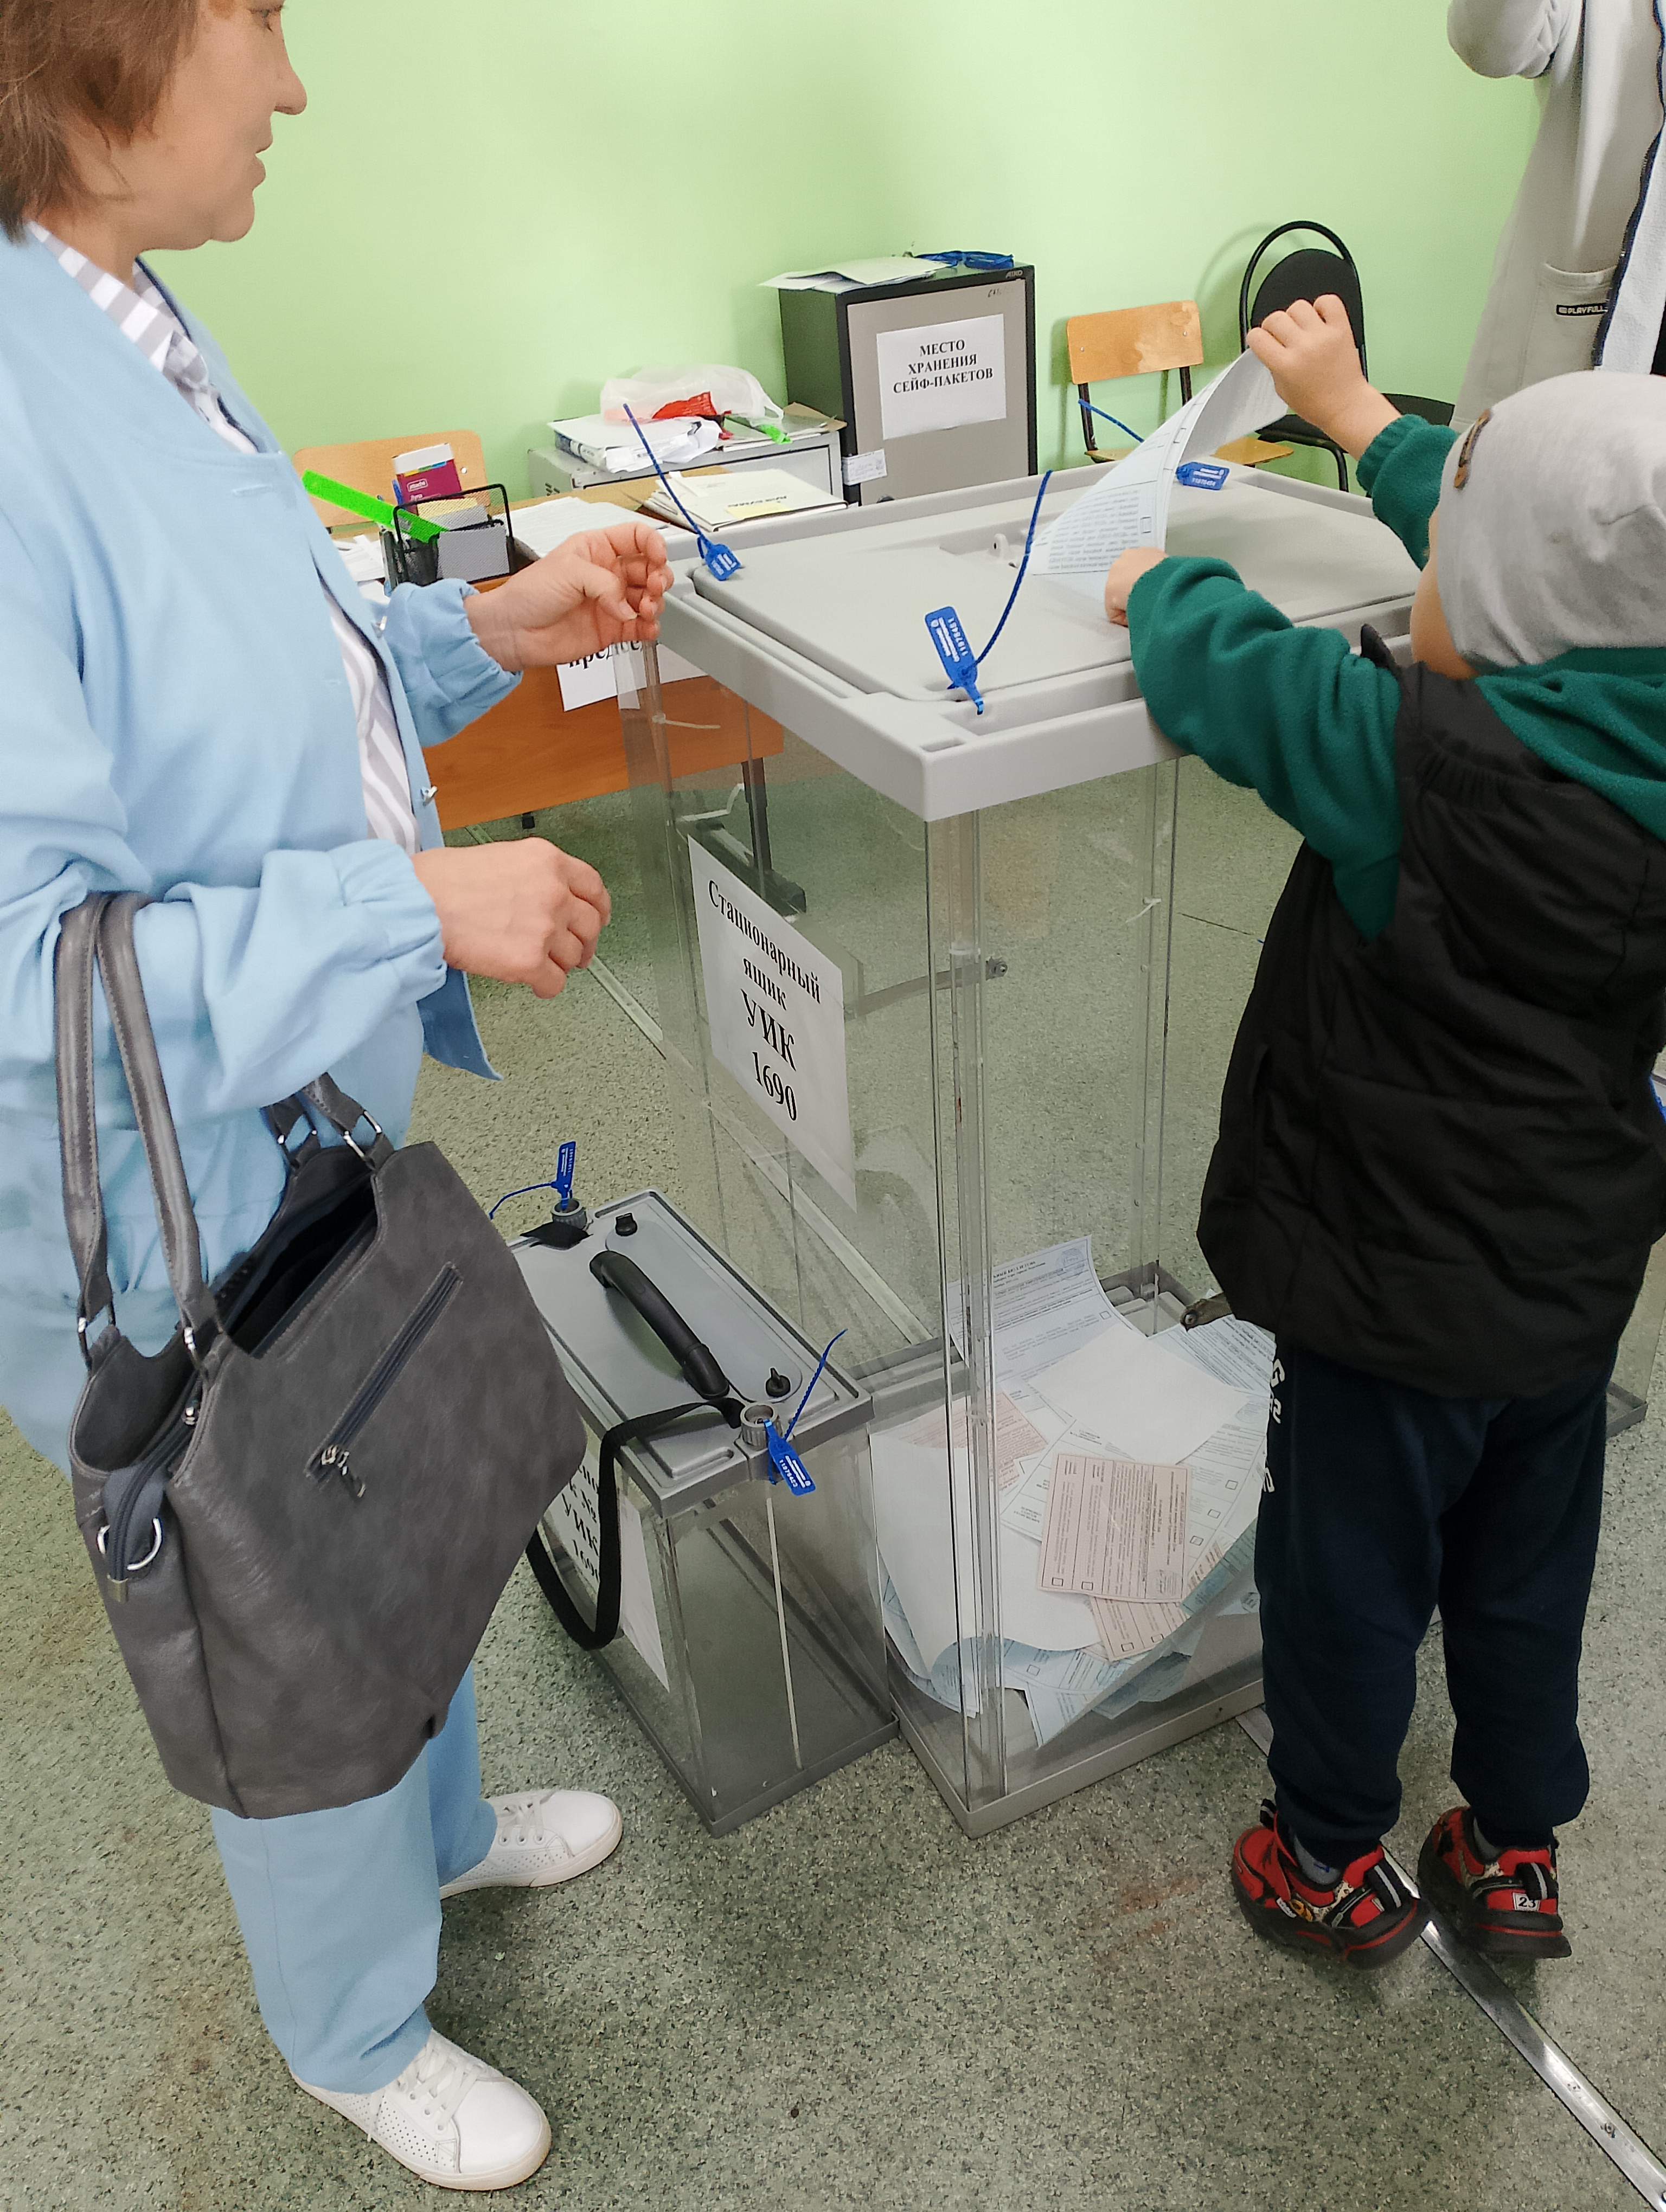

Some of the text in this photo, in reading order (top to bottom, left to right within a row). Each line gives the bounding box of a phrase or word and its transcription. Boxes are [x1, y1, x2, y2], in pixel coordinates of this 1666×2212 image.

[907, 353, 978, 375] ХРАНЕНИЯ
[920, 339, 965, 356] МЕСТО
[893, 368, 994, 394] СЕЙФ-ПАКЕТОВ
[708, 879, 822, 1004] Стационарный
[742, 957, 787, 1011] ящик
[741, 988, 797, 1071] УИК
[753, 1051, 798, 1121] 1690
[1518, 1896, 1536, 1908] 23
